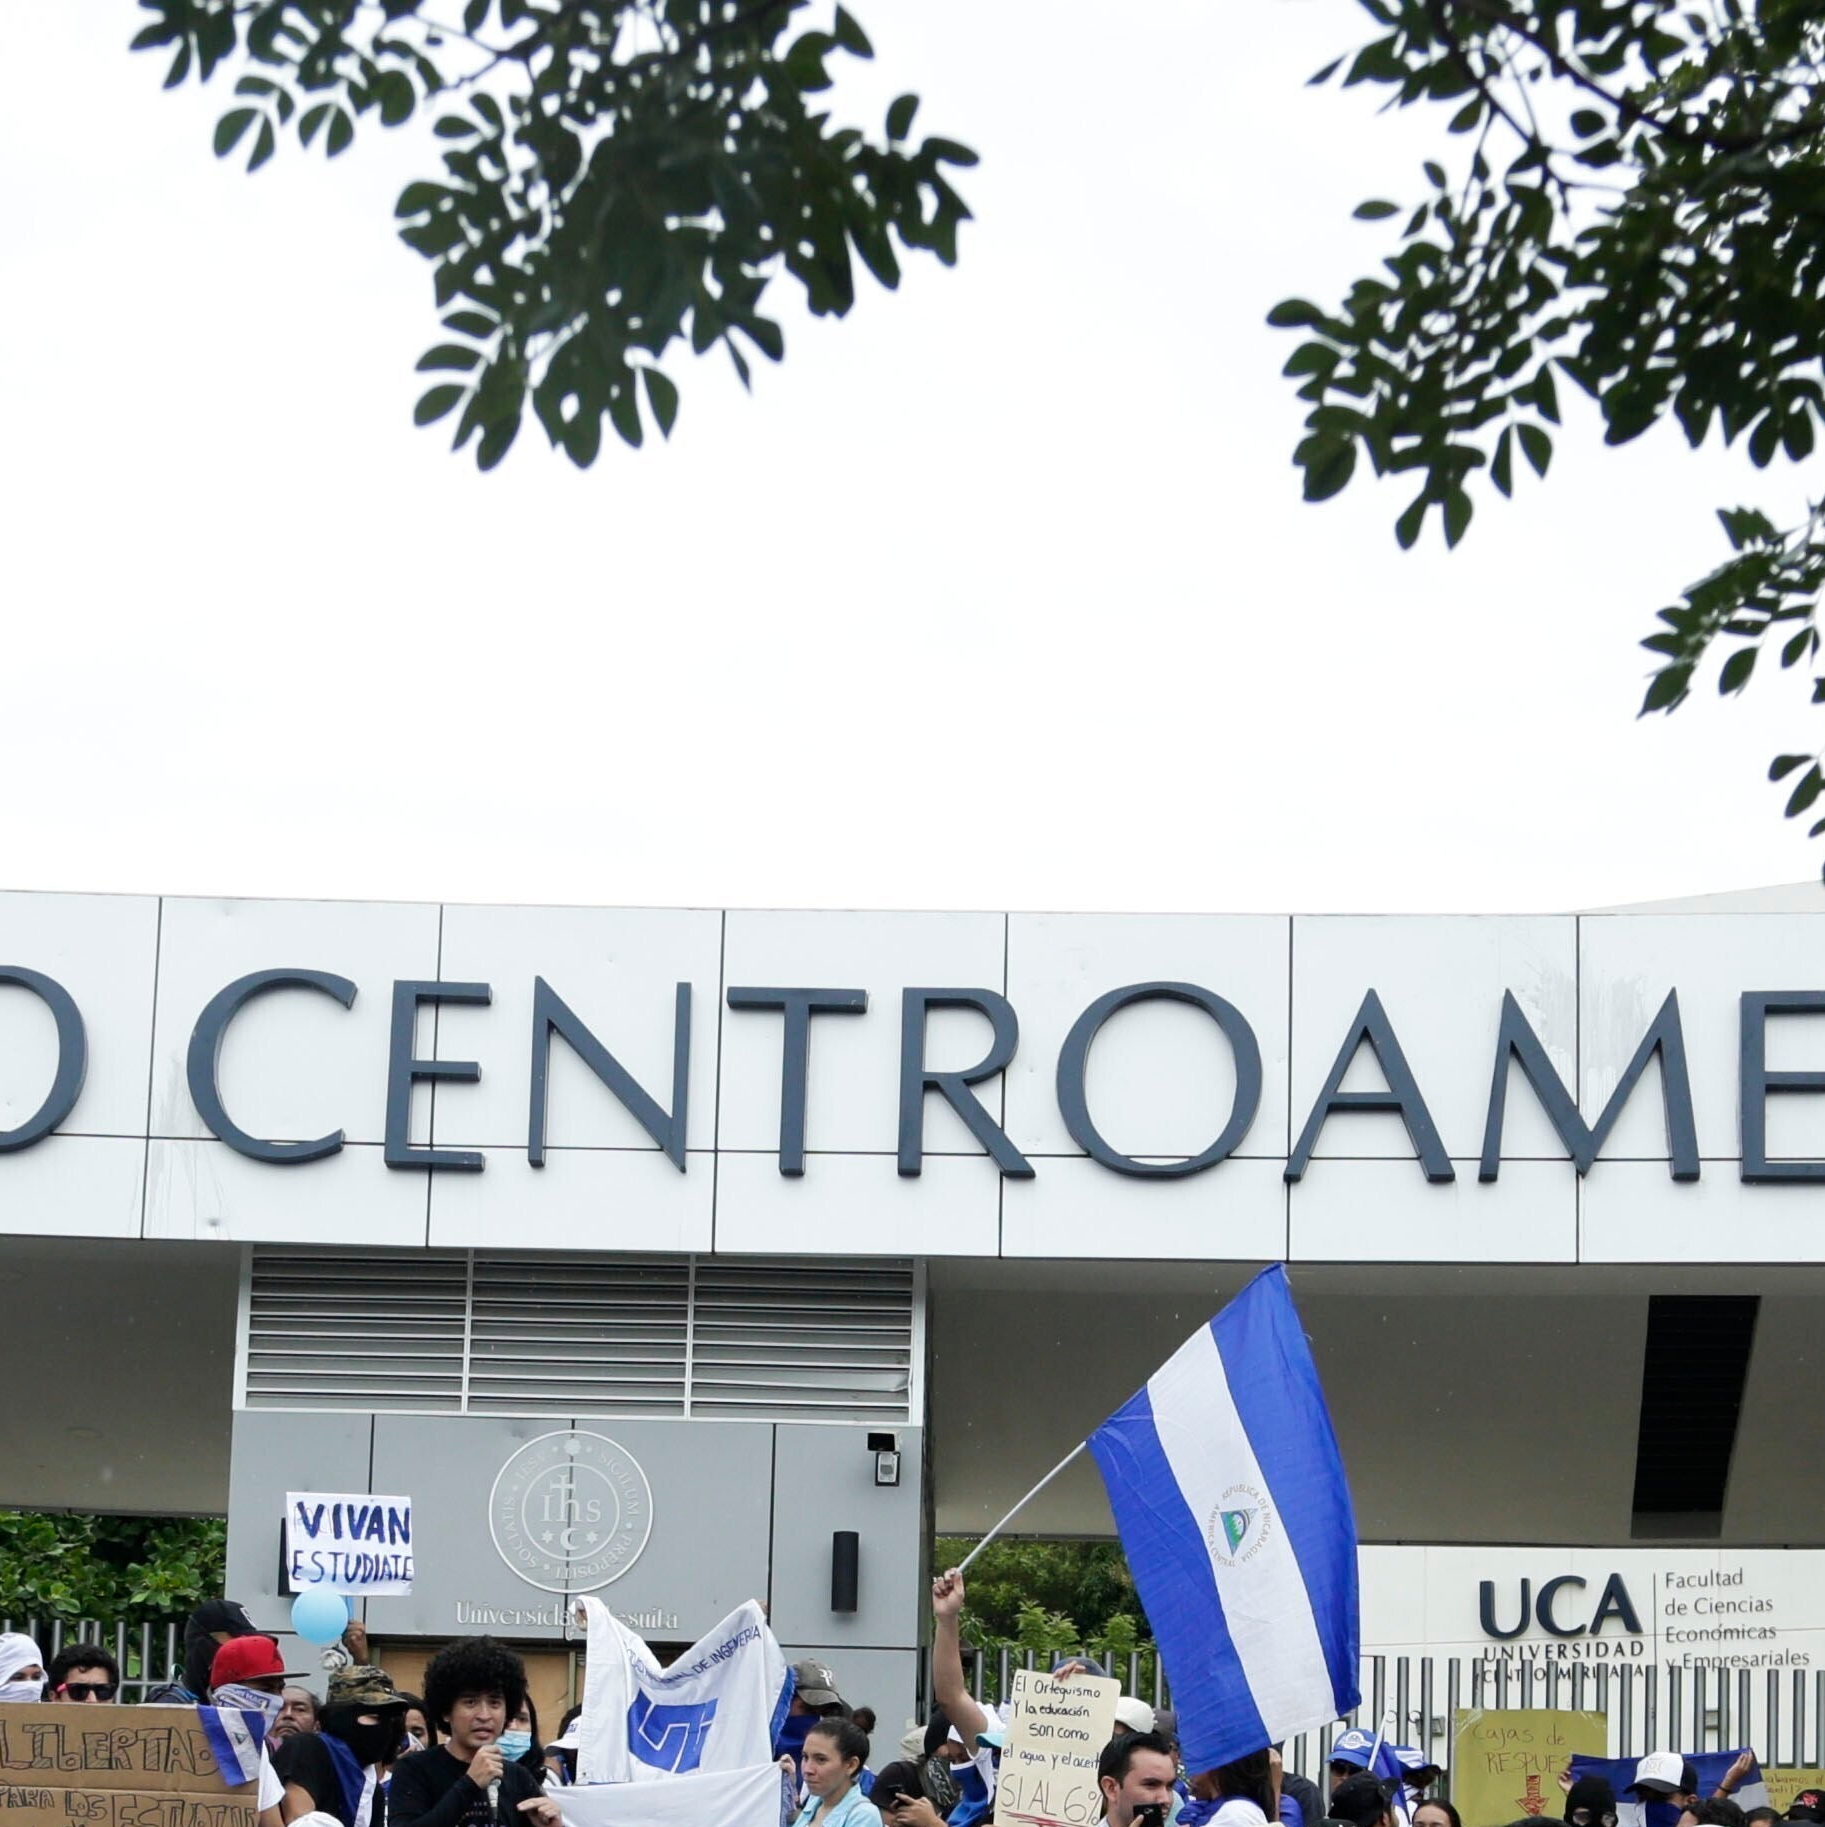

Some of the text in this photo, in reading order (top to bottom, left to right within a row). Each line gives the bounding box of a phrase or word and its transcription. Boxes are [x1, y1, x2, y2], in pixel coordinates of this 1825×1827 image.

[296, 1501, 411, 1545] VIVAN
[1665, 1568, 1744, 1589] Facultad
[455, 1600, 585, 1630] Universida
[1479, 1572, 1644, 1640] UCA
[1665, 1595, 1774, 1616] de Ciencias
[1665, 1623, 1777, 1644] Económicas
[1483, 1640, 1645, 1663] UNIVERSIDAD
[1665, 1648, 1811, 1676] y Empresariales
[1015, 1675, 1102, 1704] El Orteguismo
[1025, 1700, 1038, 1715] la
[1039, 1702, 1091, 1718] educación
[1057, 1726, 1091, 1742] como
[1471, 1722, 1566, 1750] Cajas de
[1003, 1743, 1102, 1771] el agua y el aceit
[64, 1790, 109, 1821] LOS
[1001, 1773, 1104, 1826] SI AL 6%
